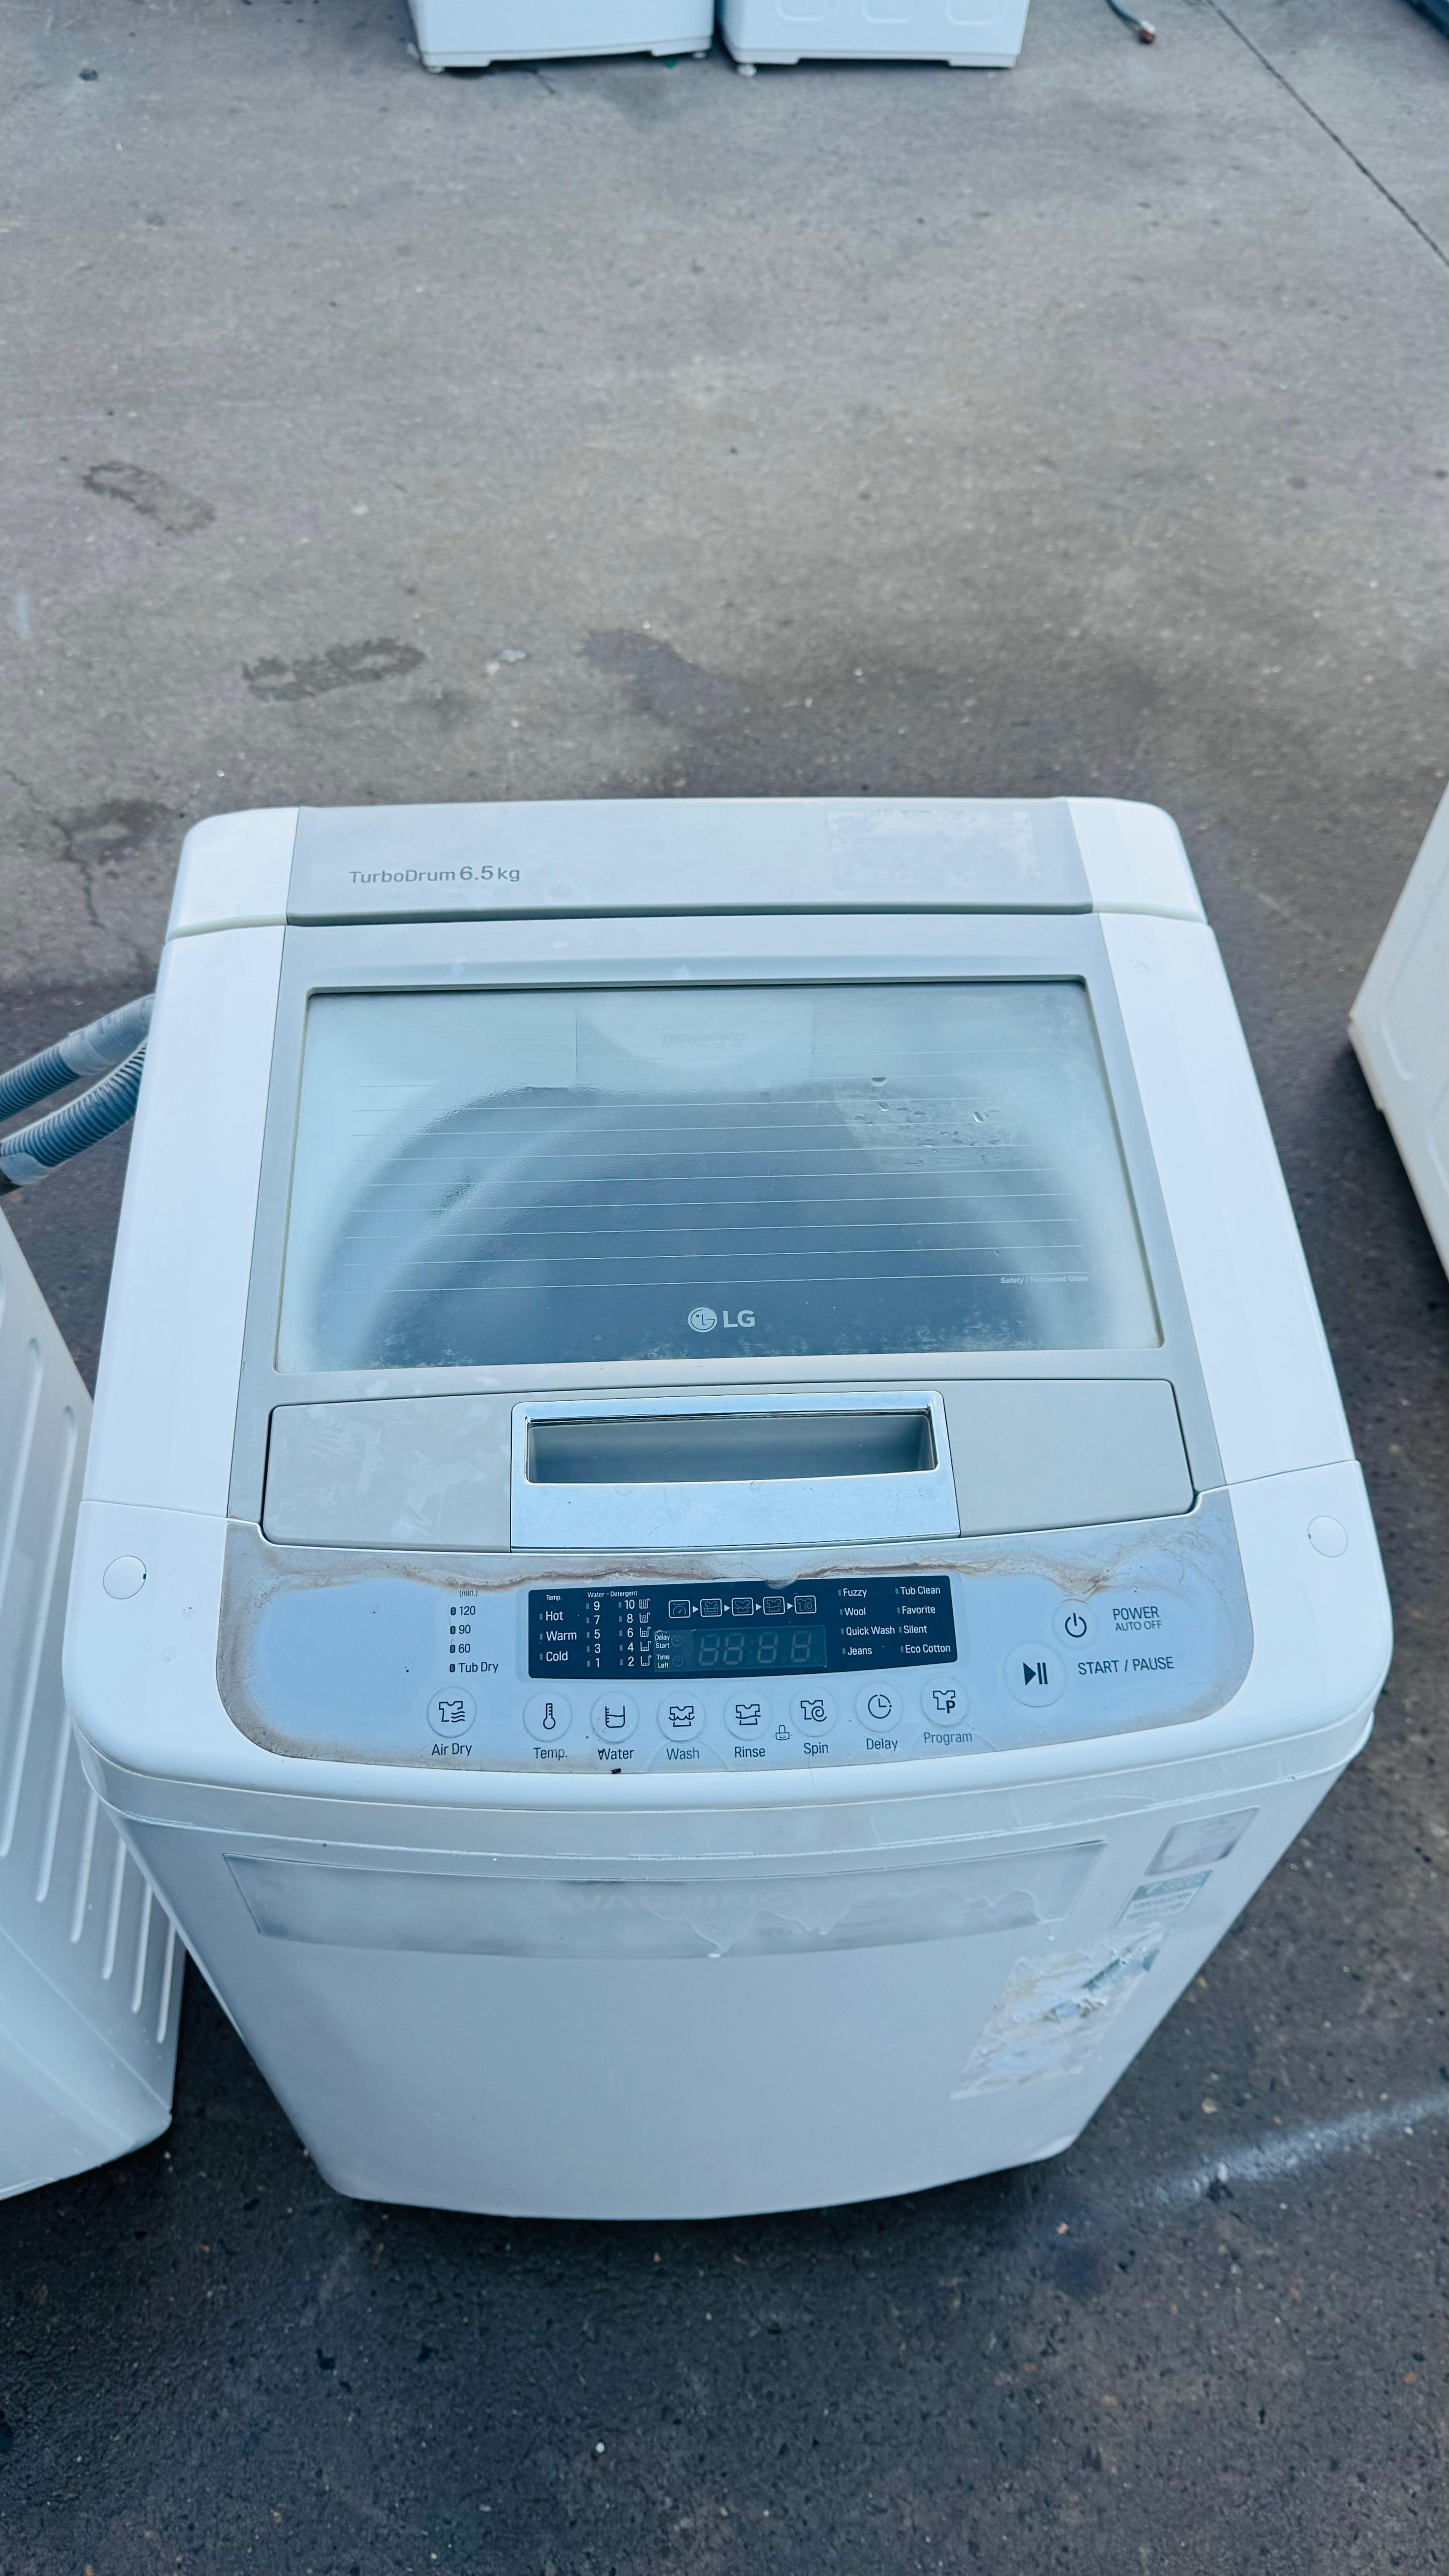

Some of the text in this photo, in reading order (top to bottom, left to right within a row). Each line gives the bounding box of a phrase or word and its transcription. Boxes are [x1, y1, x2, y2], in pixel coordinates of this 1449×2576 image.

[349, 870, 455, 883] TurboDrum
[723, 1310, 755, 1328] LG
[843, 1588, 867, 1597] Fuzzy
[900, 1586, 941, 1595] Tub Clean
[594, 1601, 600, 1611] 9
[624, 1599, 635, 1609] 10
[459, 1606, 475, 1616] 120
[844, 1607, 866, 1616] Wool
[902, 1605, 936, 1615] Favorite
[1112, 1606, 1160, 1621] POWER
[545, 1611, 564, 1622] Hot
[594, 1615, 600, 1625] 7
[626, 1614, 633, 1624] 8
[459, 1625, 471, 1634] 90
[846, 1626, 895, 1636] Quick Wash
[904, 1625, 927, 1634] Silent
[1115, 1620, 1162, 1632] AUTO OFF
[546, 1631, 577, 1641] Warm
[594, 1629, 600, 1639] 5
[627, 1628, 633, 1638] 6
[458, 1643, 470, 1653] 60
[595, 1643, 601, 1653] 3
[627, 1642, 634, 1652] 4
[847, 1647, 872, 1655] Jeans
[905, 1644, 951, 1653] Eco Cotton
[546, 1651, 568, 1662] Cold
[628, 1657, 634, 1666] 2
[458, 1662, 499, 1673] Tub Dry
[595, 1658, 600, 1668] 1
[1078, 1660, 1119, 1675] START
[1133, 1656, 1175, 1671] PAUSE
[923, 1731, 973, 1746] Program
[431, 1743, 472, 1756] Air Dry
[803, 1742, 829, 1755] Spin
[866, 1738, 898, 1752] Delay
[533, 1747, 568, 1760] Temp.
[598, 1748, 634, 1760] Water
[666, 1747, 699, 1760] Wash
[735, 1746, 766, 1758] Rinse
